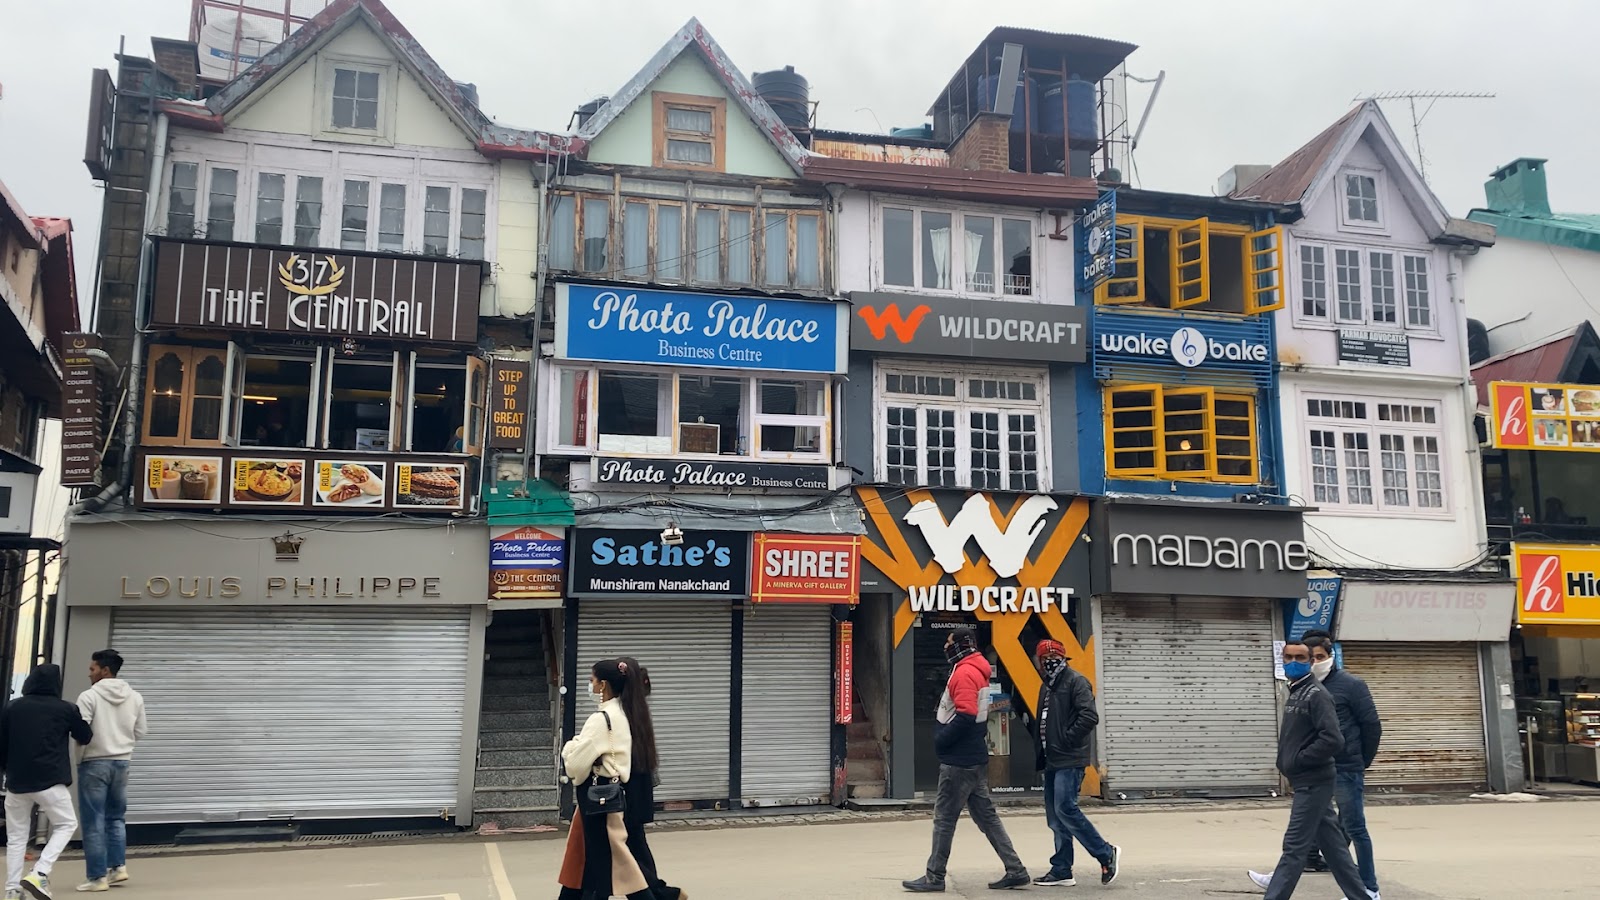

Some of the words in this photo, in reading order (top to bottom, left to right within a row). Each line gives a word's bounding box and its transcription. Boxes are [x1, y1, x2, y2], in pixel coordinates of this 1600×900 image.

[294, 258, 329, 285] 37
[206, 287, 264, 326] THE
[289, 294, 427, 336] CENTRAL
[588, 291, 693, 335] Photo
[702, 299, 820, 343] Palace
[938, 314, 1082, 345] WILDCRAFT
[1369, 332, 1407, 344] ADVOCATES
[657, 338, 716, 360] Business
[718, 342, 763, 363] Centre
[1101, 333, 1168, 355] wake
[1209, 337, 1268, 361] bake
[498, 370, 523, 382] STEP
[503, 384, 517, 396] UP
[503, 398, 516, 410] TO
[493, 411, 525, 425] GREAT
[495, 425, 521, 438] FOOD
[152, 460, 162, 485] SHAKES
[238, 463, 247, 487] BIRYANI
[321, 467, 330, 487] ROLLS
[400, 465, 410, 493] WAFFLES
[600, 460, 667, 484] Photo
[671, 462, 747, 486] Palace
[751, 477, 793, 488] Business
[795, 477, 827, 489] Centre
[493, 542, 523, 553] Photo
[526, 542, 562, 552] Palace
[590, 536, 731, 568] Sathe's
[765, 548, 850, 579] SHREE
[119, 575, 242, 599] LOUIS
[265, 576, 441, 599] PHILIPPE
[511, 574, 524, 582] THE
[526, 574, 561, 582] CENTRAL
[590, 578, 656, 591] Munshiram
[658, 578, 731, 592] Nanakchand
[820, 582, 847, 590] GALLERY
[1566, 572, 1600, 597] Hi
[906, 585, 1075, 614] WILDCRAFT
[1319, 595, 1335, 626] bake
[1373, 590, 1487, 610] NOVELTIES
